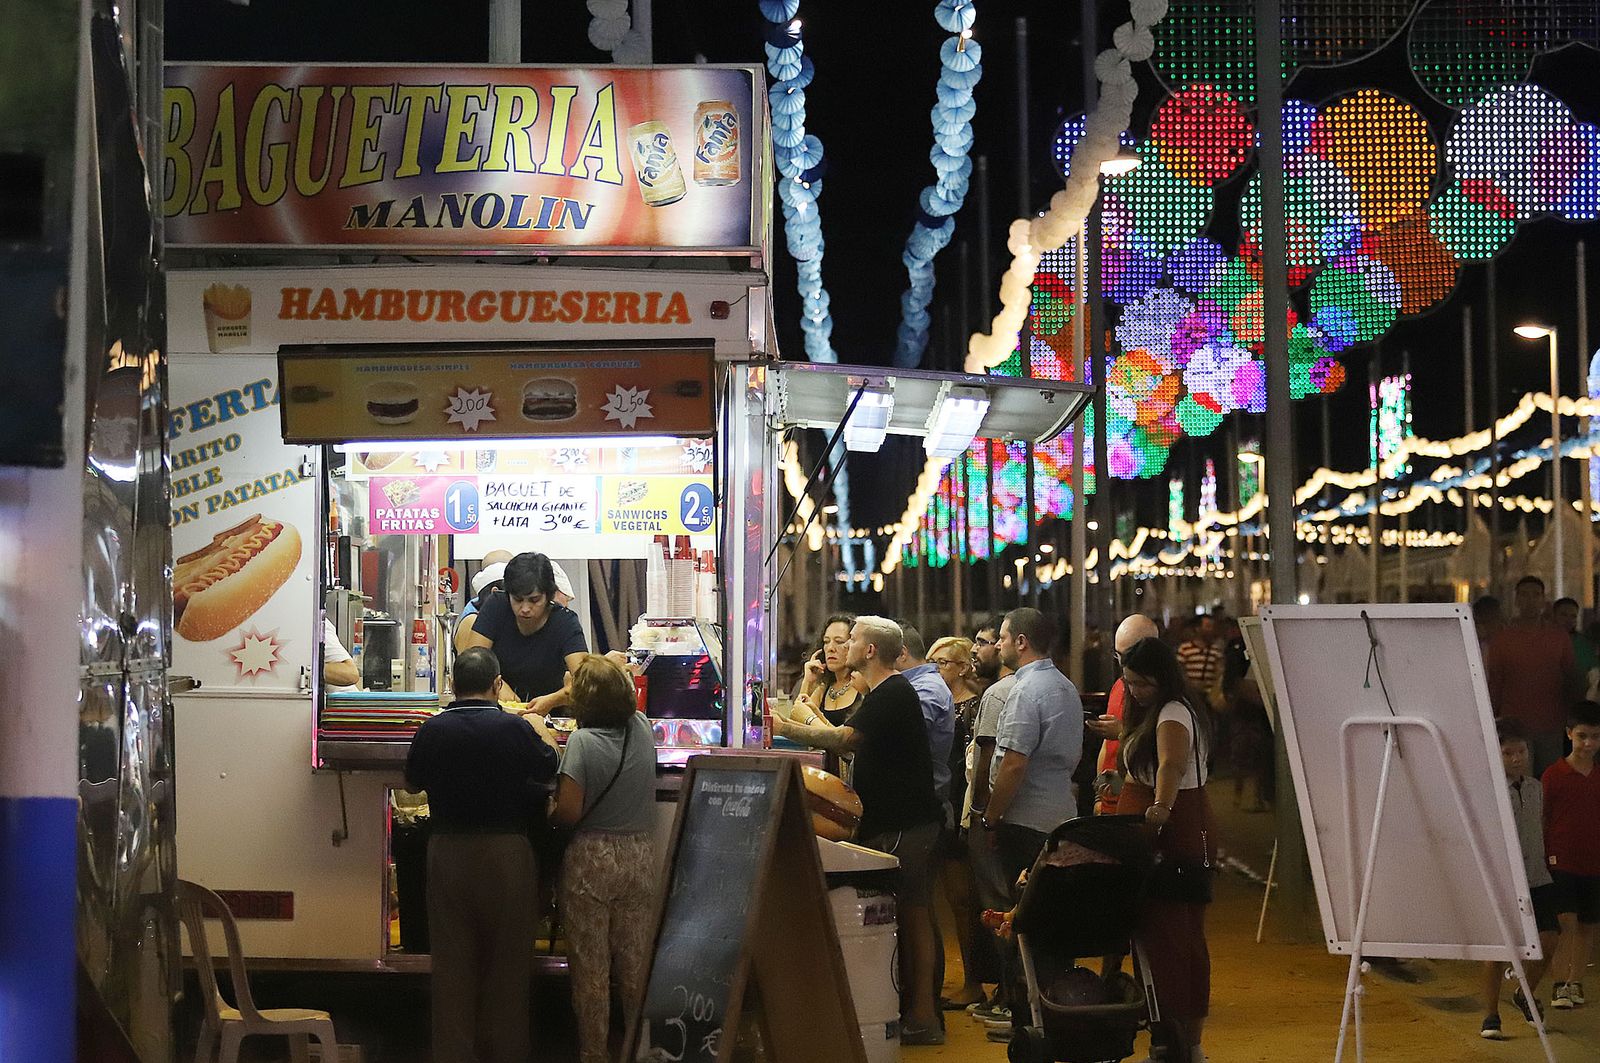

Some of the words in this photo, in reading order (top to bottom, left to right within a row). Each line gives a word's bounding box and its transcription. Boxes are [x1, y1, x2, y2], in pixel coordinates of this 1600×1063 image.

[163, 80, 623, 217] BAGUETERIA
[696, 112, 736, 164] Fanta
[638, 133, 669, 188] Fanta
[344, 193, 596, 229] MANOLIN
[277, 287, 692, 324] HAMBURGUESERIA
[448, 488, 461, 523] 1
[484, 481, 552, 497] BAGUET
[559, 486, 575, 497] DE
[486, 501, 538, 511] SALCHICHA
[375, 508, 440, 519] PATATAS
[381, 519, 435, 531] FRITAS
[607, 509, 668, 520] SANWICHS
[683, 490, 700, 525] 2
[613, 521, 662, 531] VEGETAL
